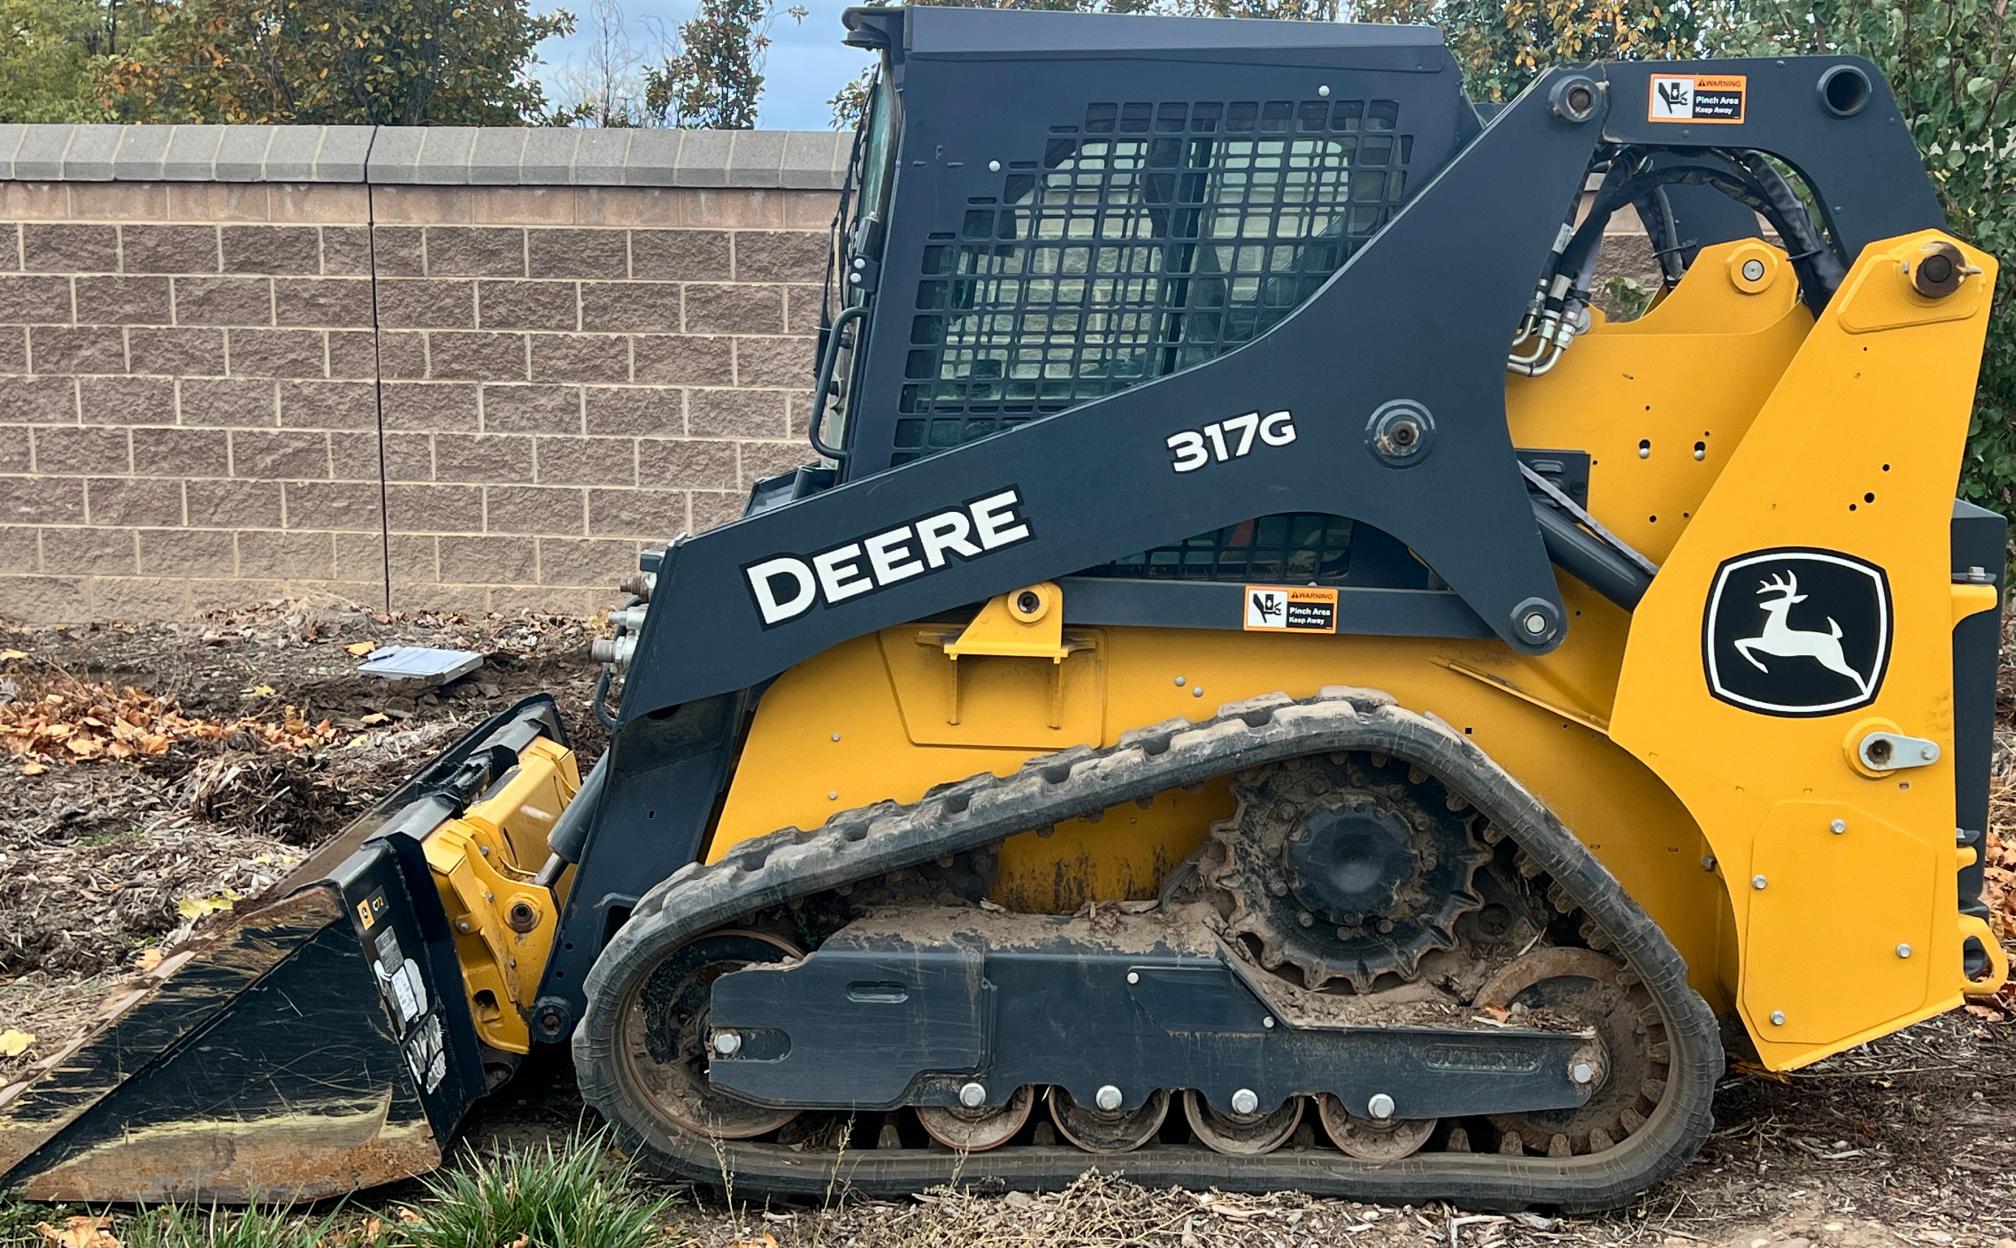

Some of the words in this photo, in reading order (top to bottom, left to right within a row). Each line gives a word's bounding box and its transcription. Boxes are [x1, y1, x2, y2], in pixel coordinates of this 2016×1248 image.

[1696, 96, 1718, 104] Pinch
[1720, 96, 1739, 105] Area
[1695, 106, 1713, 114] Keep
[1714, 107, 1733, 115] Away
[1166, 411, 1296, 473] 317G
[746, 490, 1030, 626] DEERE
[1299, 591, 1333, 599] WARNING
[1289, 607, 1311, 615] Pinch
[1312, 608, 1331, 616] Area
[1307, 617, 1325, 625] Away
